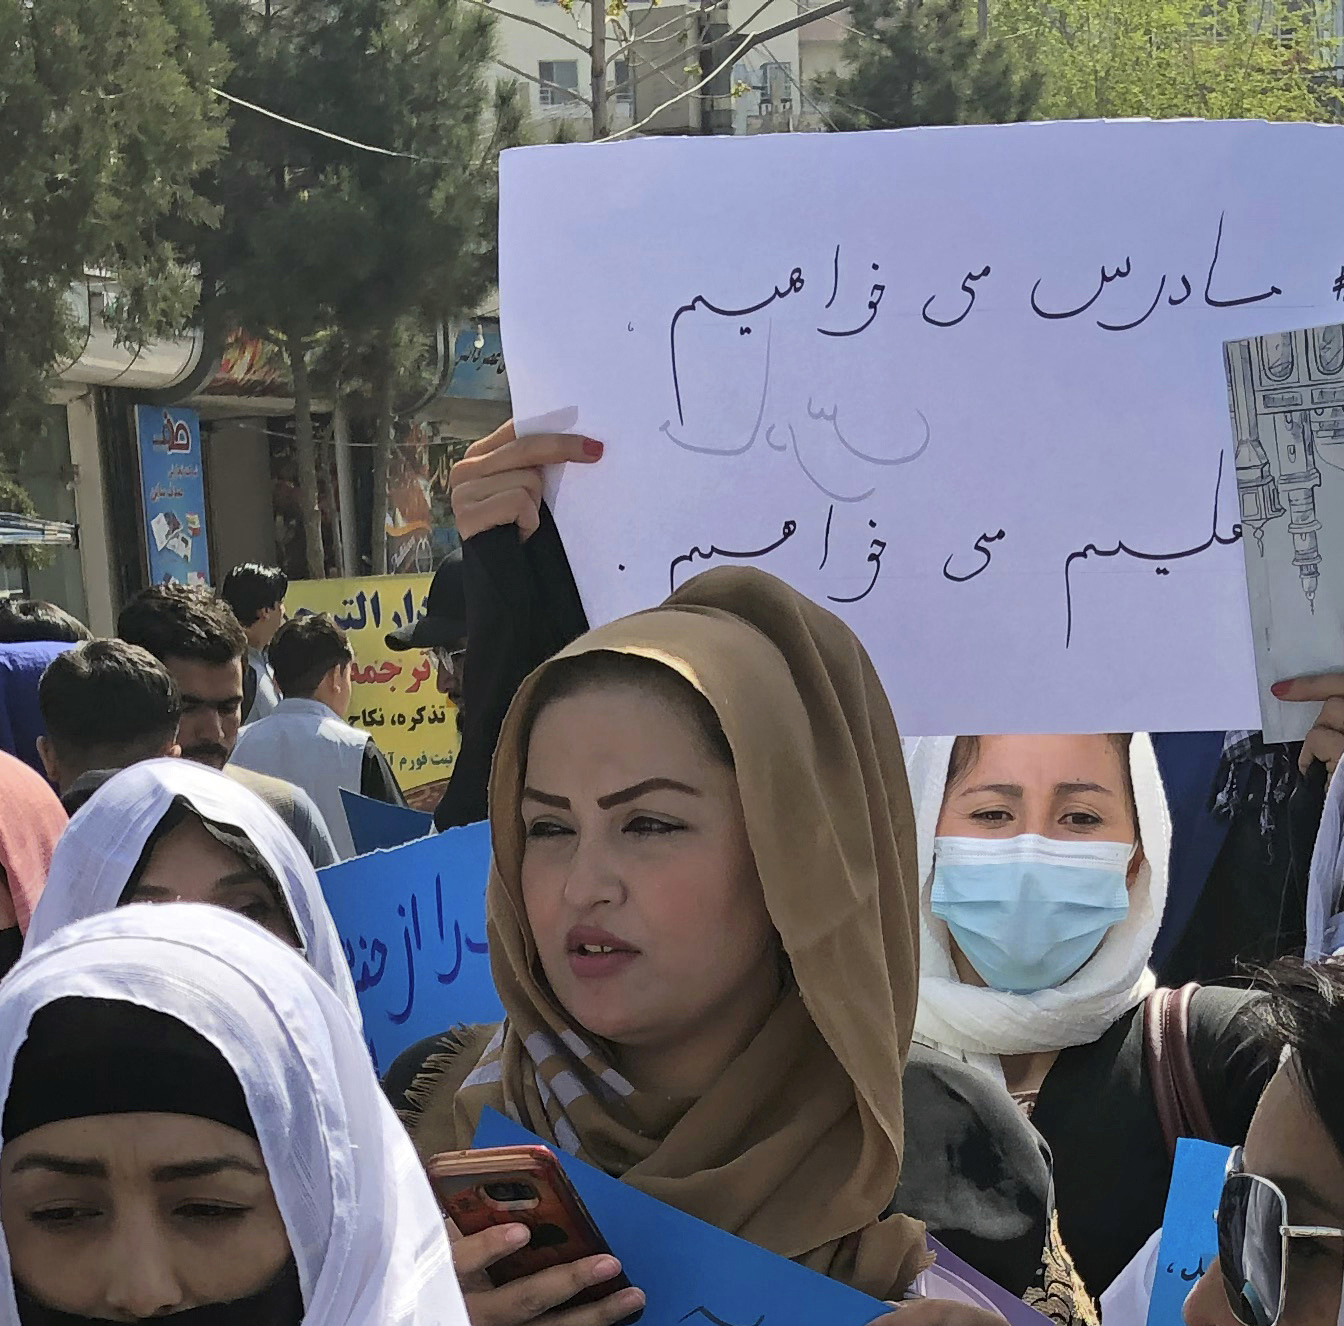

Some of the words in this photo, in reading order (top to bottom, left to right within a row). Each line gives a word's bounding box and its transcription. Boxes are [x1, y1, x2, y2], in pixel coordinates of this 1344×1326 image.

[921, 262, 994, 327] می
[942, 525, 1007, 583] می
[1064, 448, 1243, 650] علیم
